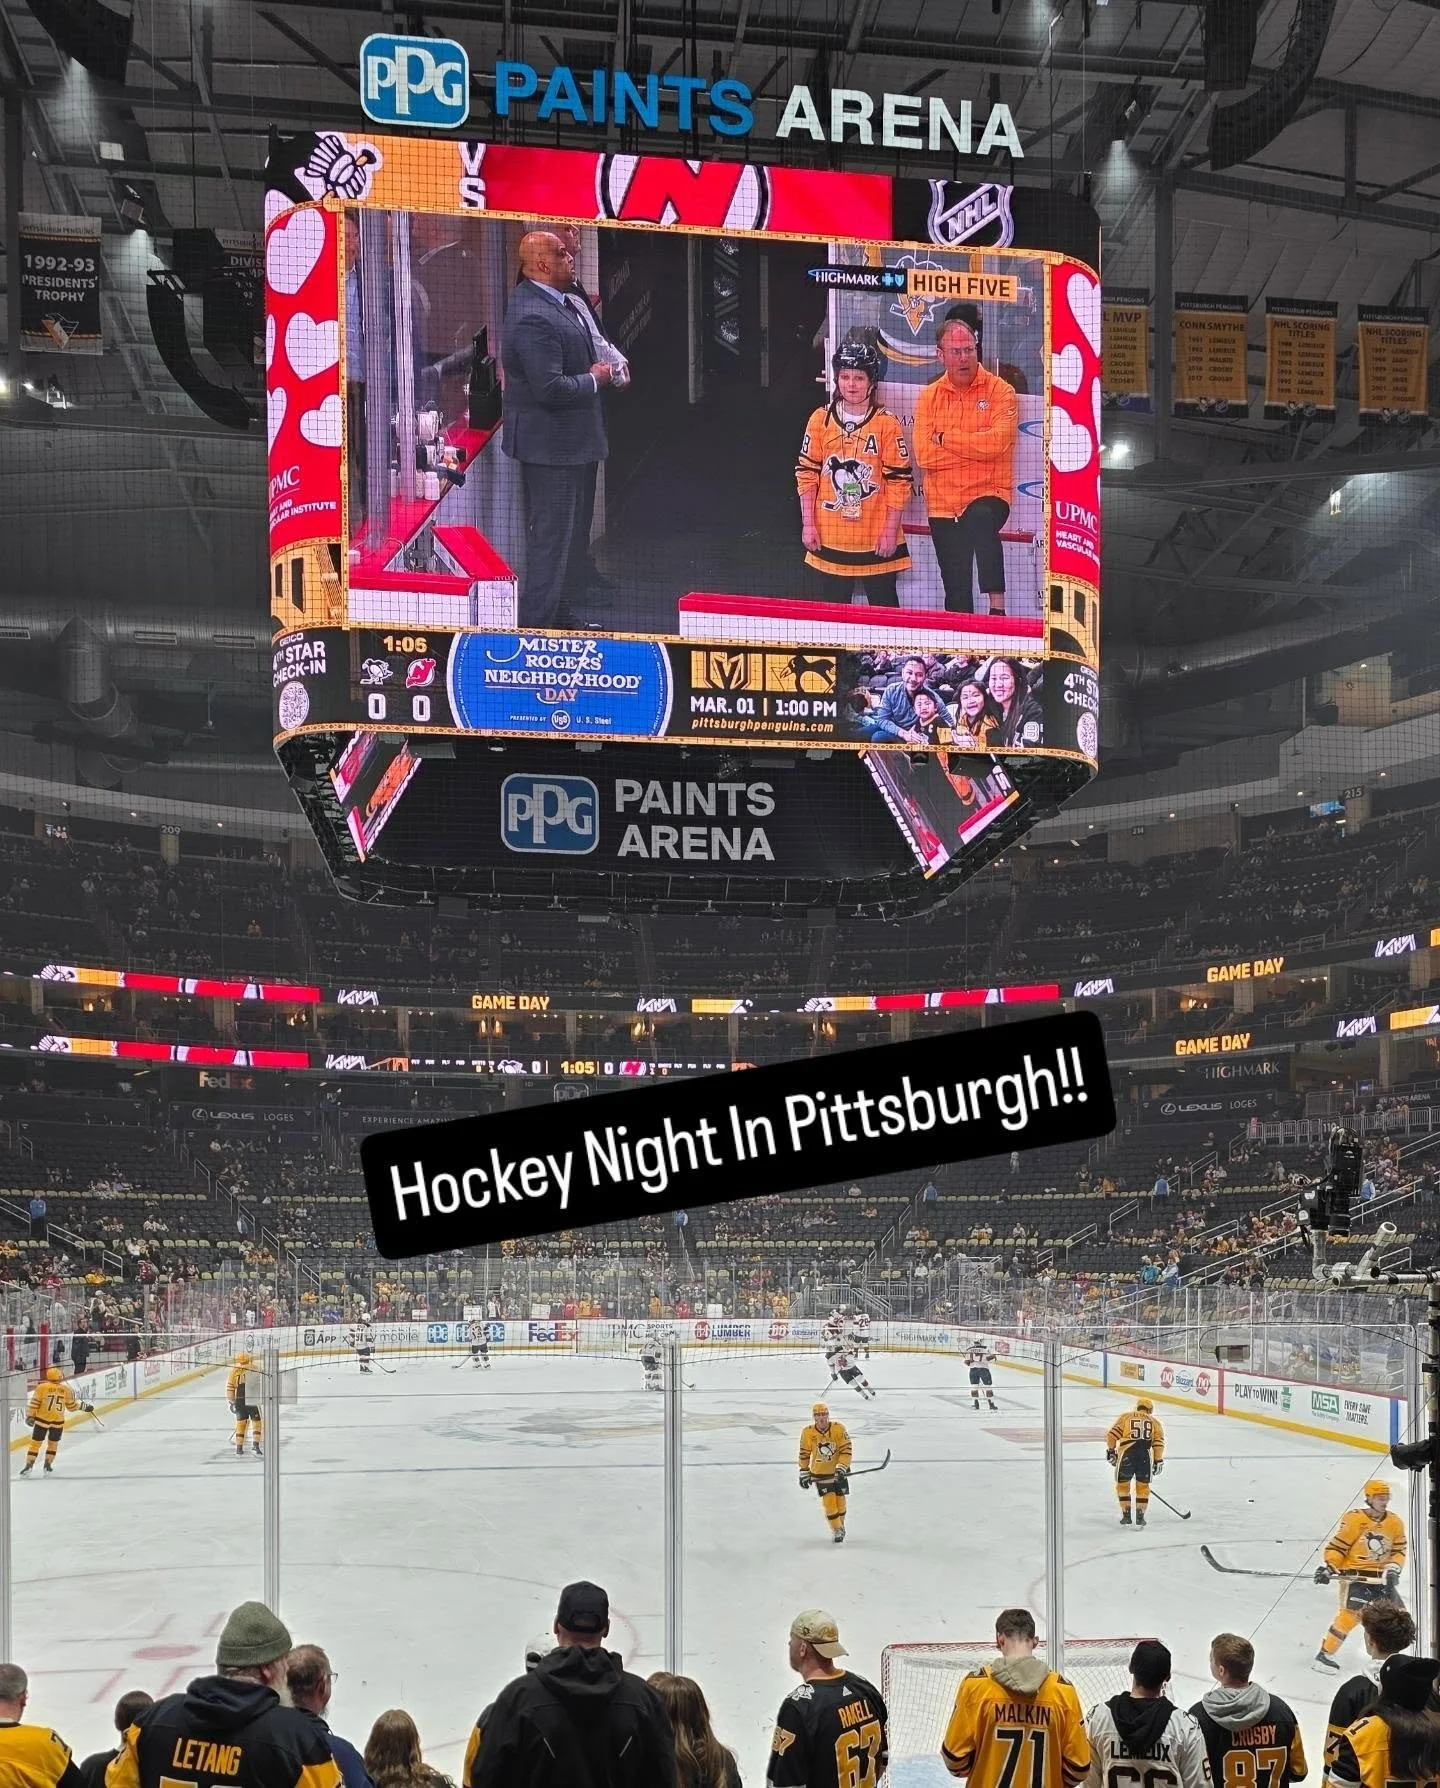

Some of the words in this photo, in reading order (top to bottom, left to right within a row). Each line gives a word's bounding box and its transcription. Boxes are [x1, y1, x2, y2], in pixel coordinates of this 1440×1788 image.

[367, 45, 463, 115] PPG
[495, 60, 755, 138] PAINTS
[775, 84, 1025, 158] ARENA
[947, 191, 998, 240] NHL
[24, 254, 95, 273] 1992-93
[22, 274, 99, 289] PRESIDENTS'
[815, 269, 880, 287] HIGHMARK
[913, 274, 961, 295] HIGH
[967, 277, 1011, 298] FIVE
[35, 289, 85, 302] TROPHY
[1113, 311, 1142, 324] MVP
[1180, 320, 1206, 330] CONN
[1207, 321, 1246, 332] SMYTHE
[1274, 320, 1292, 330] NHL
[1292, 321, 1330, 332] SCORING
[1288, 329, 1316, 339] TITLES
[1366, 328, 1383, 337] NHL
[1384, 329, 1422, 339] SCORING
[1381, 336, 1408, 346] TITLES
[864, 435, 878, 455] A
[896, 437, 908, 458] 5
[269, 465, 300, 504] PMC
[290, 501, 336, 516] INSTITUTE
[1055, 500, 1098, 534] UPMC
[1056, 530, 1082, 543] HEART
[1056, 539, 1093, 558] VASCULAR
[280, 632, 304, 647] GEICO
[500, 637, 598, 658] MISTER
[285, 640, 326, 664] STAR
[272, 659, 327, 688] CHECK-IN
[484, 669, 640, 690] NEIGHBORHOOD
[1063, 672, 1085, 688] 4TH
[543, 688, 577, 703] DAY
[368, 693, 387, 720] 0
[412, 694, 431, 722] 0
[690, 696, 732, 714] MAR.
[736, 698, 755, 715] 01
[776, 700, 809, 717] 1:00
[812, 701, 837, 718] PM
[594, 717, 612, 725] Steel
[691, 717, 834, 734] pittsburghpenguins.com
[1344, 787, 1363, 800] 215
[508, 783, 592, 844] PPG
[615, 778, 776, 817] PAINTS
[160, 825, 181, 835] 209
[617, 824, 776, 861] ARENA
[1206, 963, 1251, 984] GAME
[1253, 956, 1285, 978] DAY
[472, 994, 516, 1010] GAME
[518, 995, 551, 1011] DAY
[1175, 1036, 1219, 1057] GAME
[1221, 1032, 1251, 1052] DAY
[532, 1060, 541, 1074] 0
[561, 1061, 595, 1075] 1:05
[604, 1062, 613, 1075] 0
[1204, 1062, 1280, 1079] HIGHMARK
[199, 1071, 256, 1090] FedEx
[1178, 1102, 1223, 1112] LEXUS
[1230, 1099, 1257, 1109] LOGES
[209, 1111, 255, 1121] LEXUS
[263, 1113, 294, 1122] LOGES
[362, 1117, 415, 1125] EXPERIENCE
[428, 1324, 448, 1343] PPG
[528, 1322, 577, 1342] FedEx
[712, 1324, 751, 1338] LUMBER
[900, 1332, 937, 1343] HIGHMARK
[1198, 1378, 1209, 1392] DQ
[1234, 1383, 1252, 1399] PLAY
[1260, 1387, 1278, 1405] WIN!
[47, 1395, 65, 1412] 75
[1312, 1393, 1338, 1413] MSA
[1130, 1419, 1152, 1440] 58
[838, 1699, 874, 1729] RAKELL
[994, 1703, 1051, 1726] MALKIN
[1231, 1725, 1277, 1748] CROSBY
[172, 1737, 243, 1776] LETANG
[834, 1720, 882, 1788] 67
[995, 1726, 1047, 1788] 71
[1222, 1746, 1288, 1788] 87
